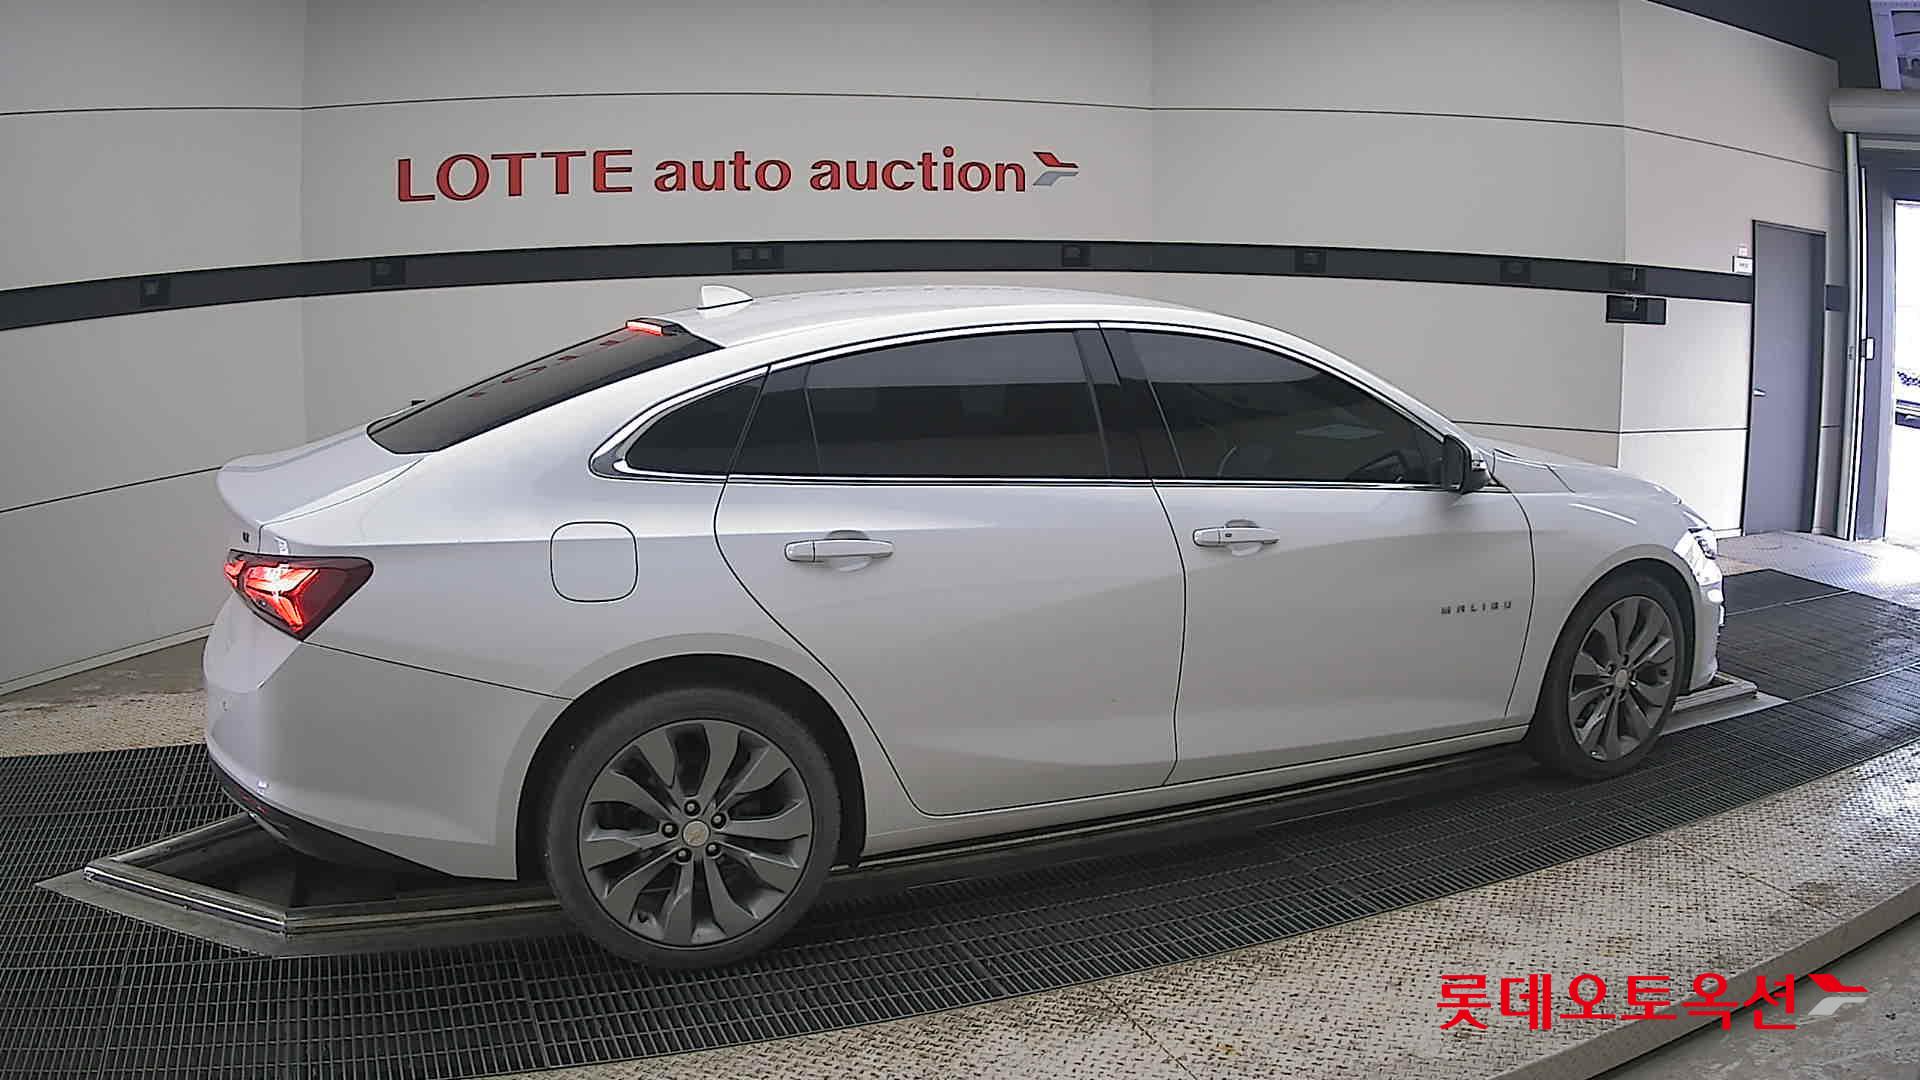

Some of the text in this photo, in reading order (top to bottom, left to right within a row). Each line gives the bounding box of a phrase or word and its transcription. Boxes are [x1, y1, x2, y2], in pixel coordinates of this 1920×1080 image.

[397, 146, 1026, 202] LOTTE auto auction
